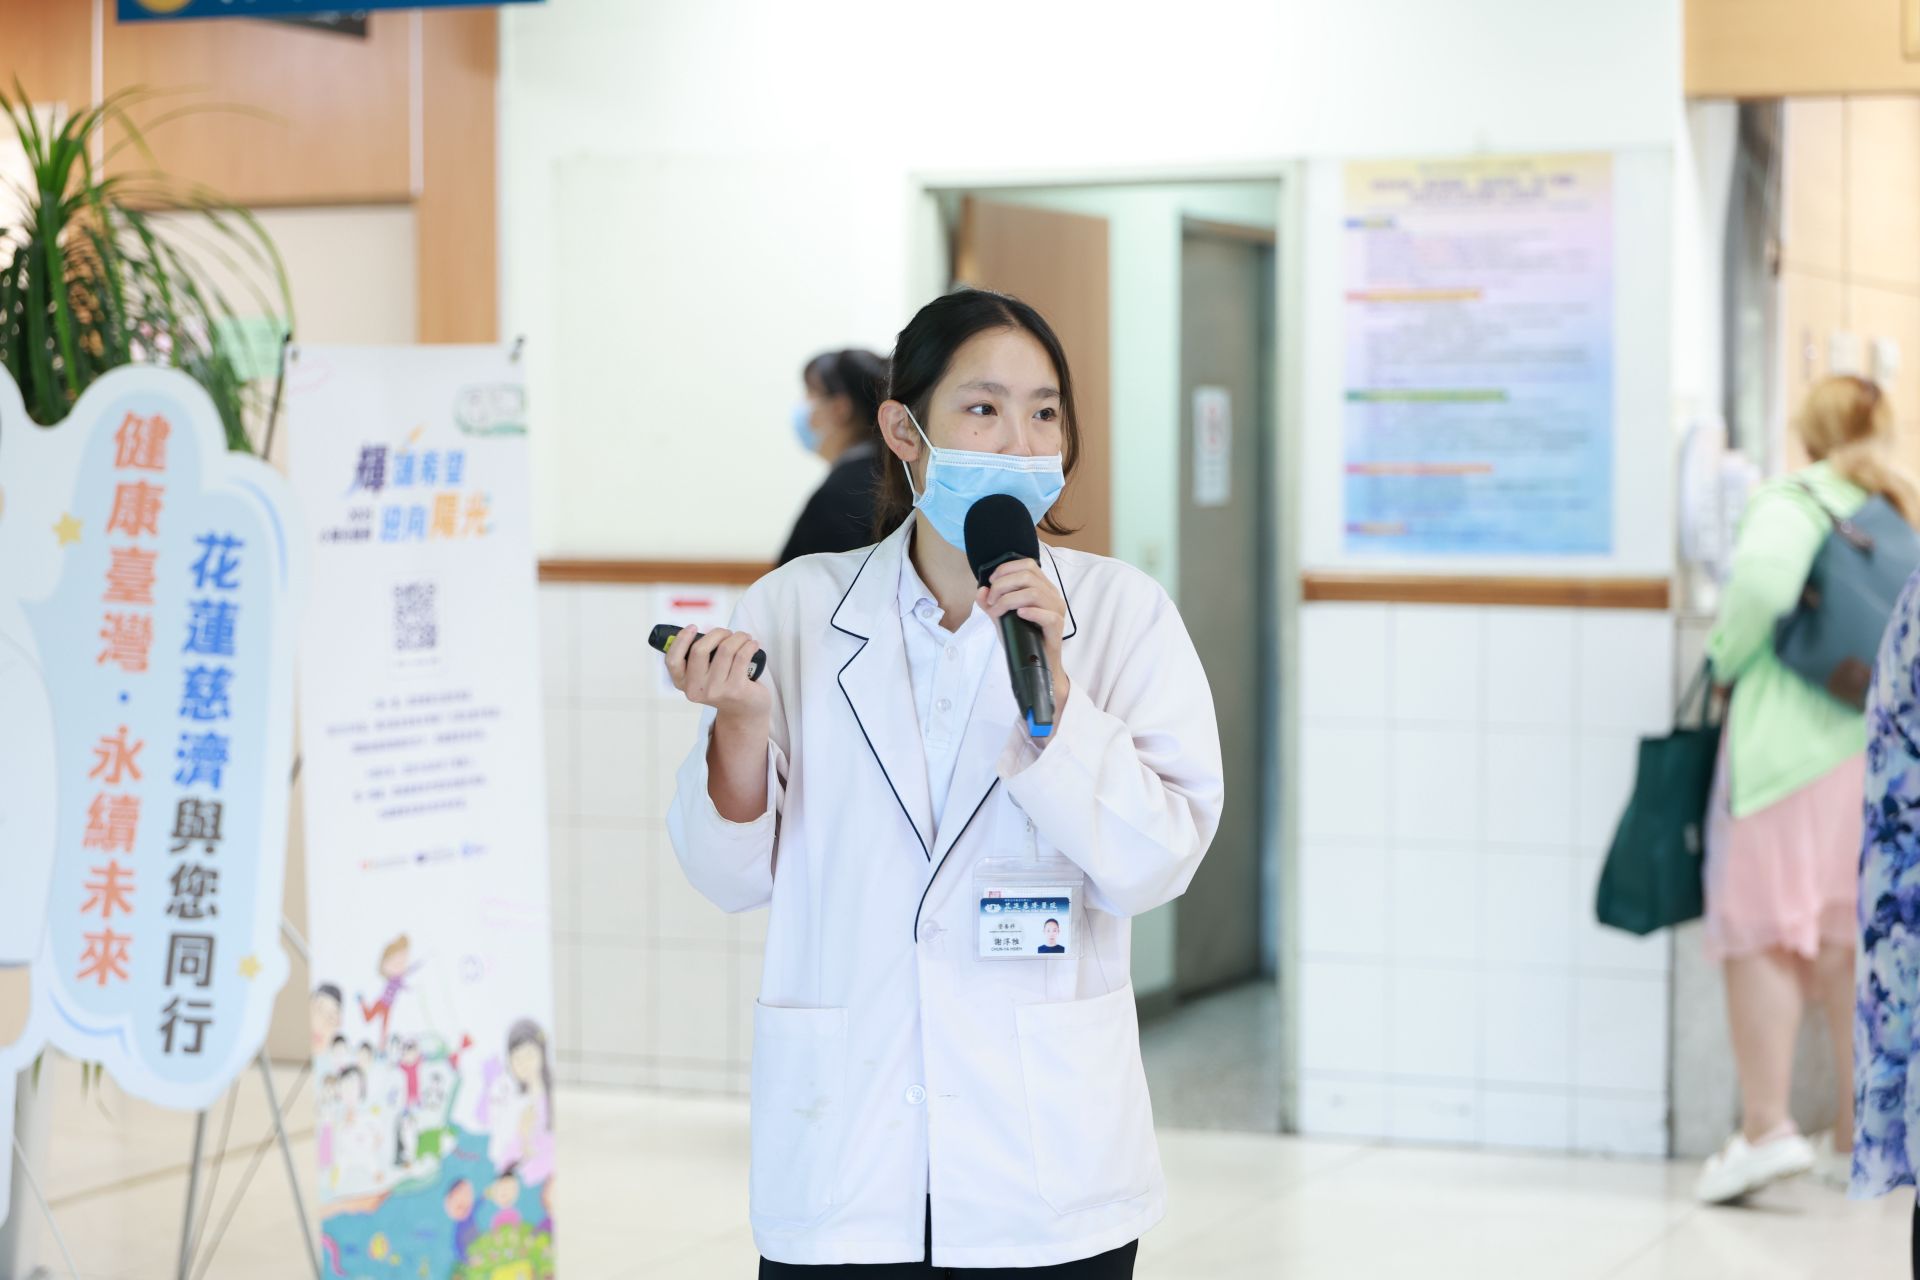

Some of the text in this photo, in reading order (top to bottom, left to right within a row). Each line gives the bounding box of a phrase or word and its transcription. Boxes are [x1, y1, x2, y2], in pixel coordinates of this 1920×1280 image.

[160, 531, 246, 1056] 花蓮慈濟與您同行
